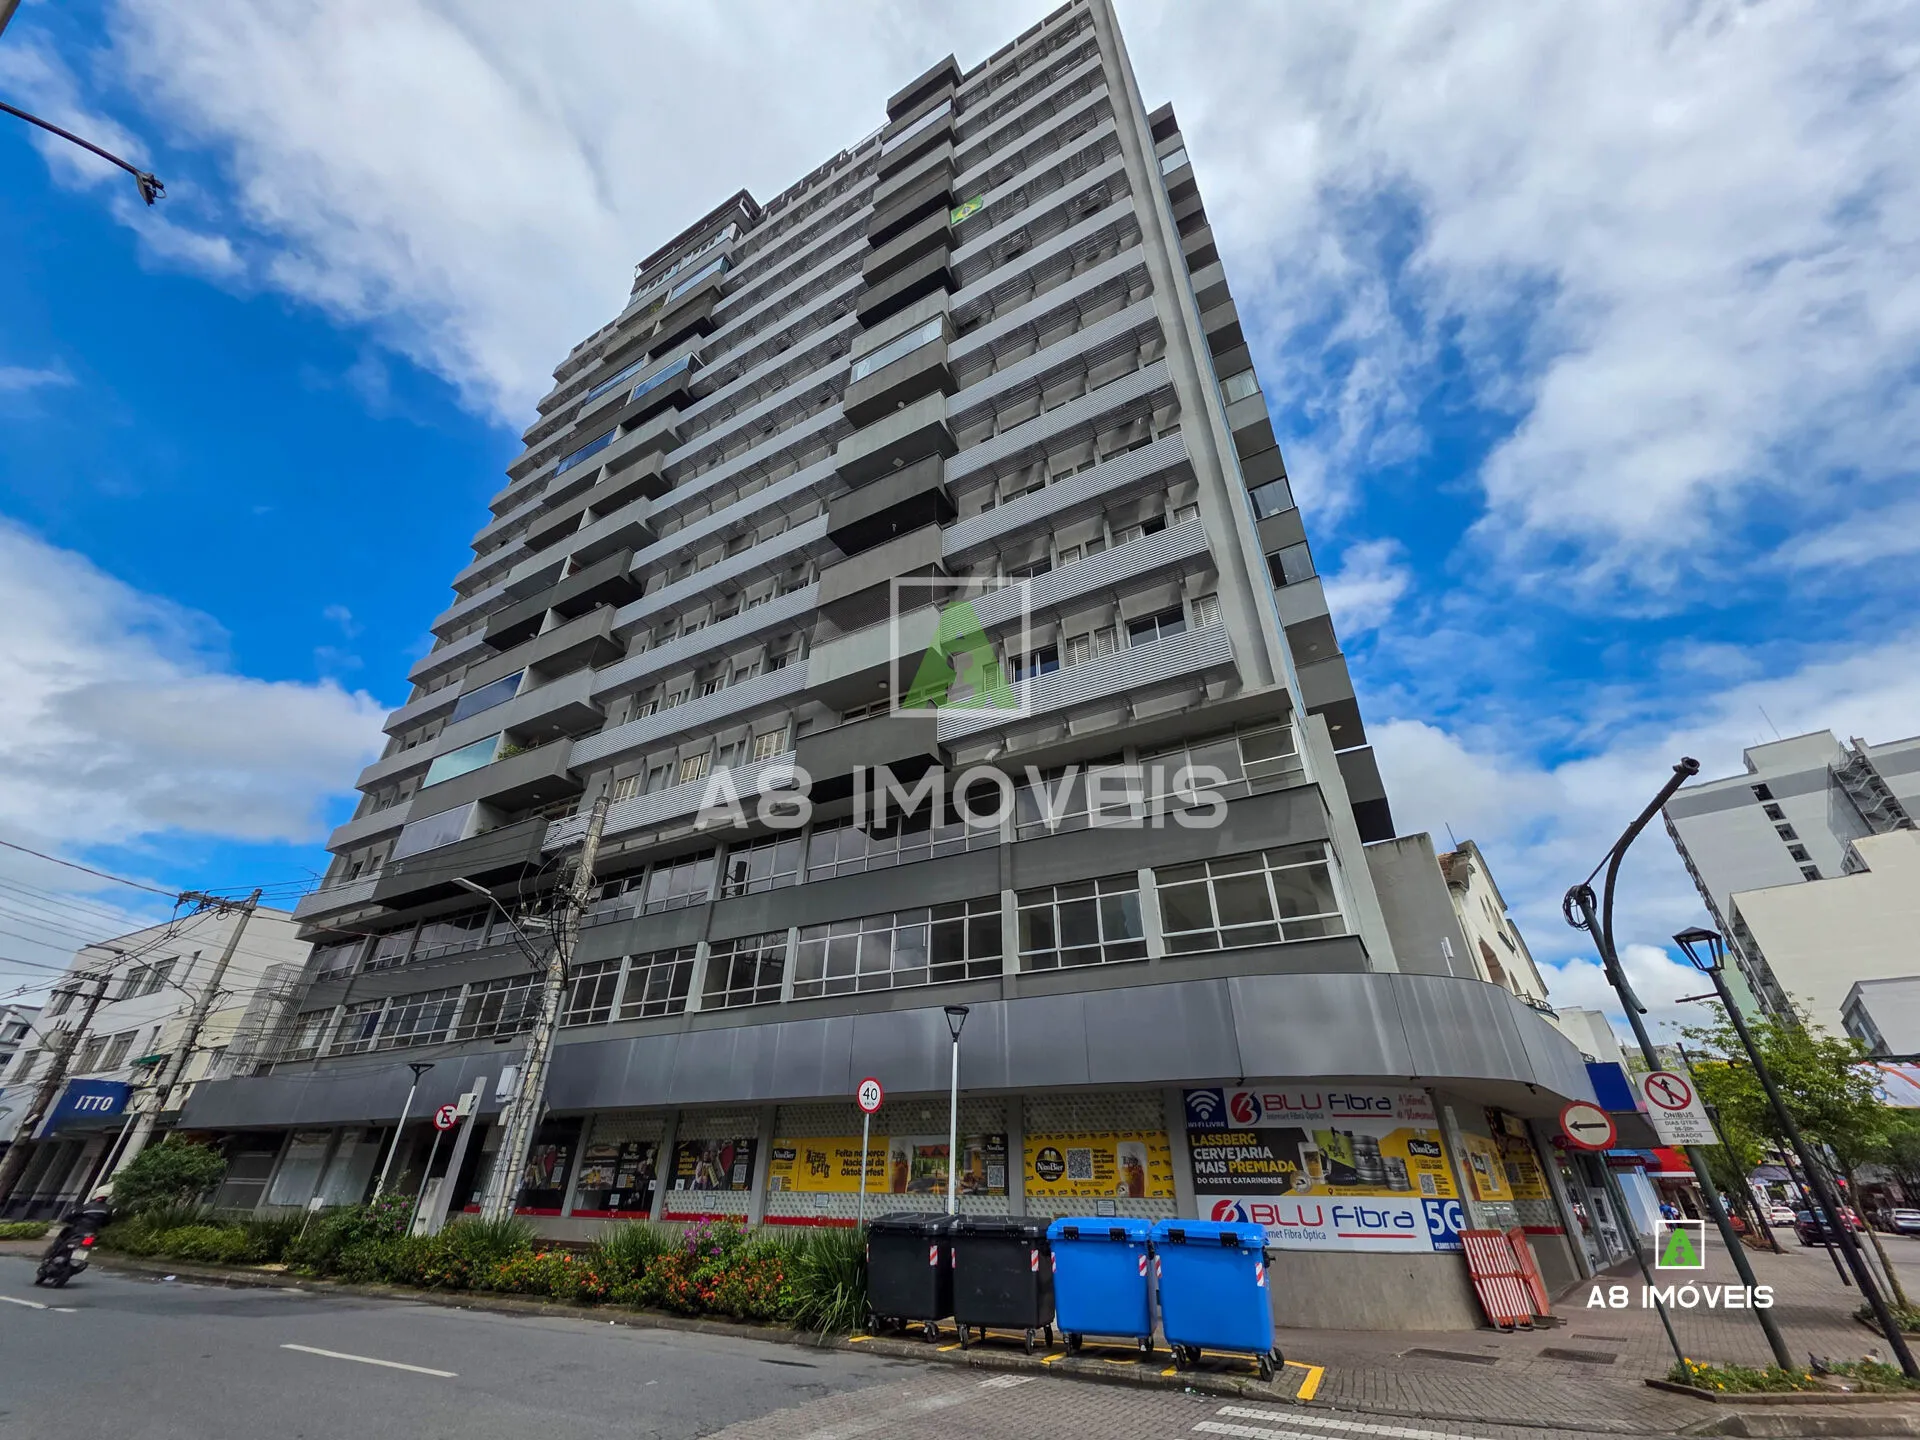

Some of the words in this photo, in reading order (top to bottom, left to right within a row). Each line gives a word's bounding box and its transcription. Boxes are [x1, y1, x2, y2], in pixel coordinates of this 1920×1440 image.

[863, 1087, 877, 1100] 40
[74, 1095, 114, 1111] ITTO
[1263, 1093, 1322, 1111] BLU
[1328, 1093, 1391, 1110] Fibra
[1191, 1133, 1257, 1147] LASSBERG
[835, 1149, 853, 1157] Feita
[1193, 1147, 1273, 1161] CERVEJARIA
[875, 1159, 885, 1167] da
[1195, 1161, 1227, 1174] MAIS
[1228, 1160, 1297, 1173] PREMIADA
[841, 1168, 884, 1177] Oktobrfest
[1250, 1204, 1323, 1226] BLU
[1332, 1205, 1414, 1228] Fibra
[1426, 1201, 1467, 1235] 5G
[1284, 1229, 1301, 1239] Fibra
[1302, 1228, 1327, 1242] Óptica
